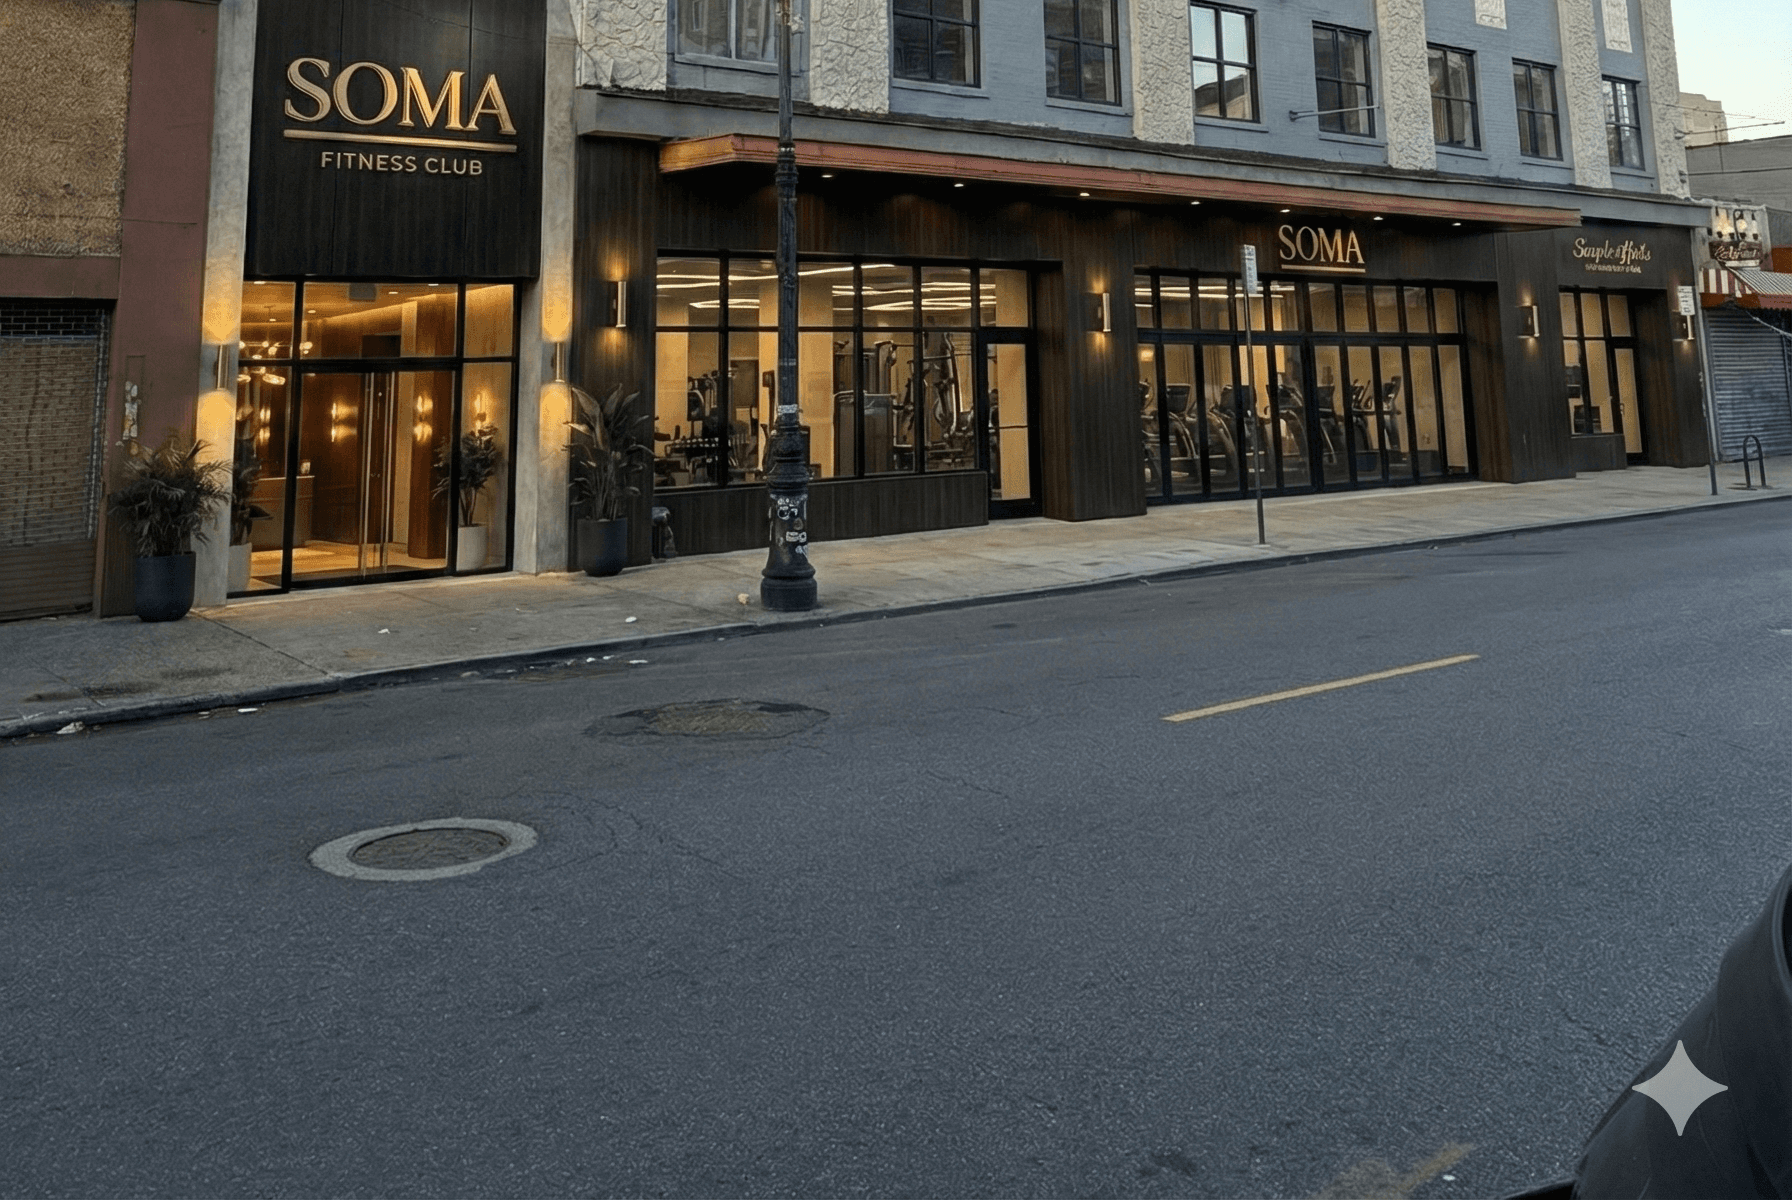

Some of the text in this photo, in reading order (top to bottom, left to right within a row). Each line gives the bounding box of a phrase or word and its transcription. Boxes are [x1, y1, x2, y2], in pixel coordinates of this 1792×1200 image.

[285, 57, 517, 134] SOMA
[321, 152, 483, 175] FITNESS CLUB
[1278, 225, 1364, 263] SOMA
